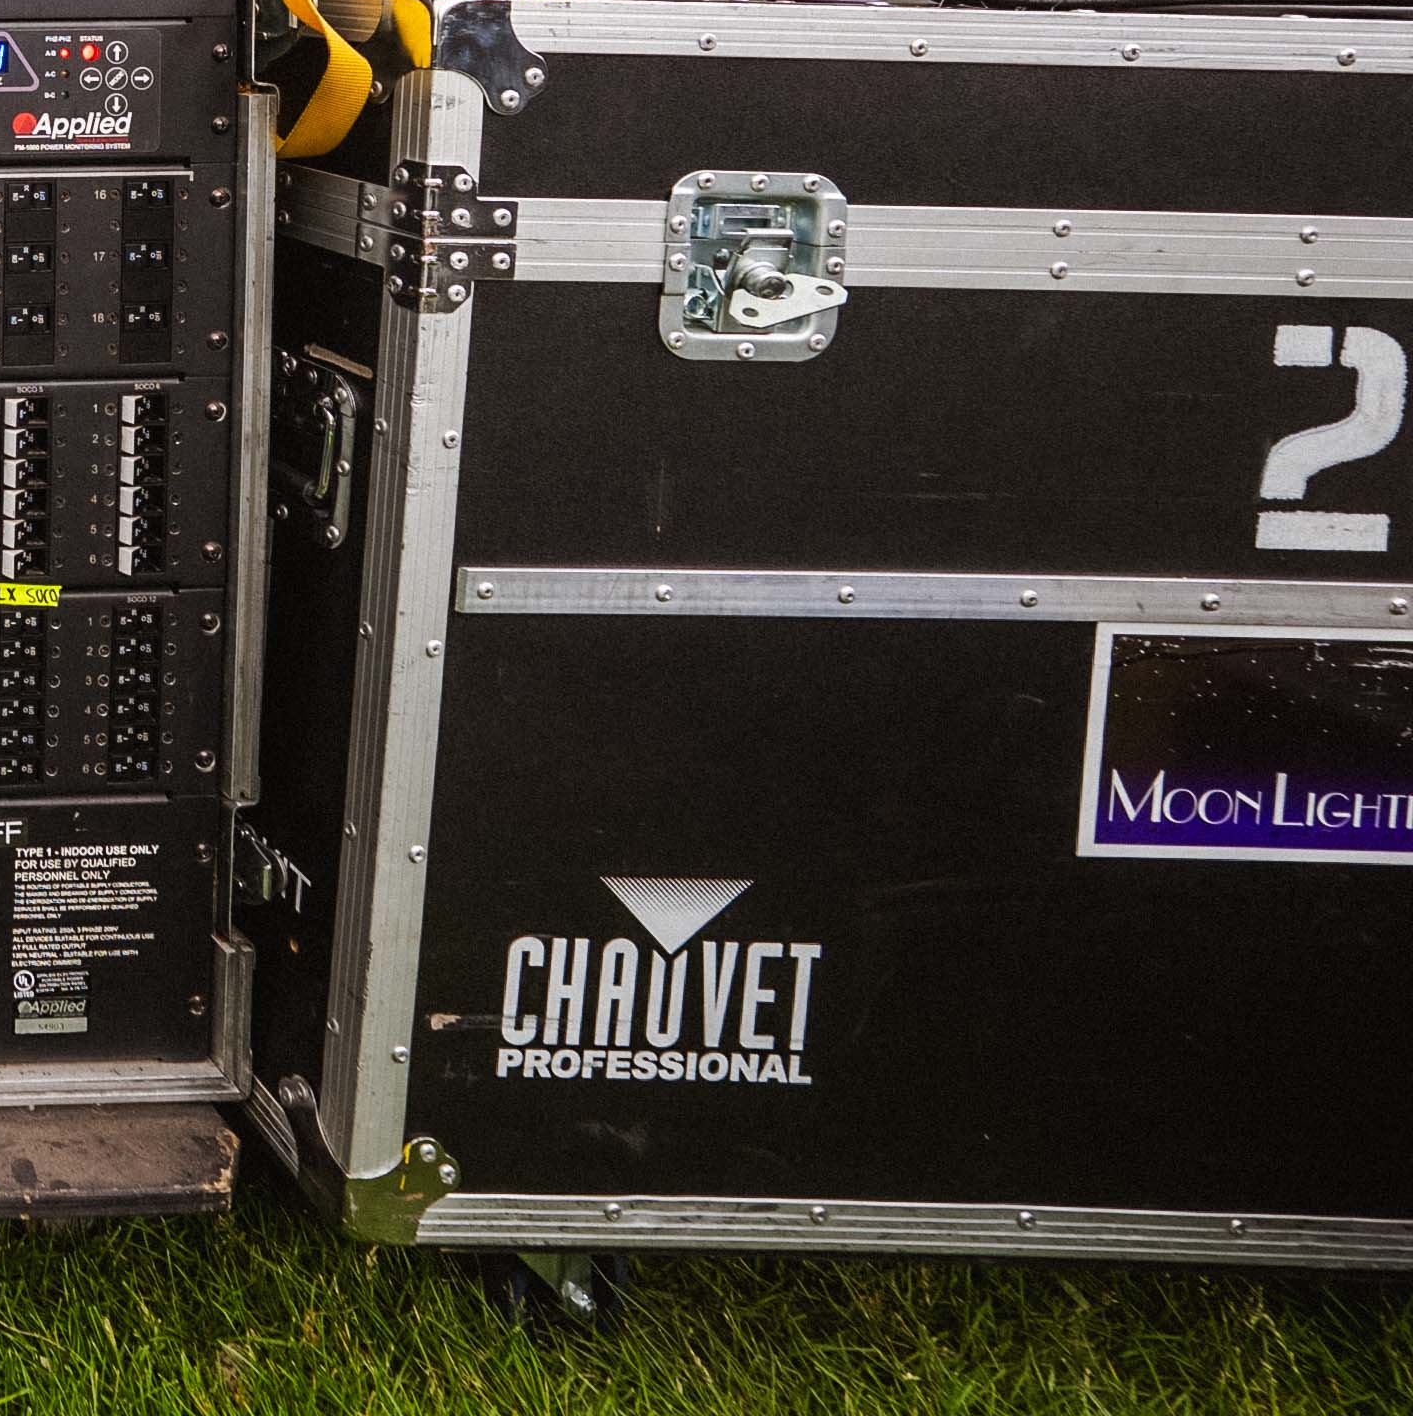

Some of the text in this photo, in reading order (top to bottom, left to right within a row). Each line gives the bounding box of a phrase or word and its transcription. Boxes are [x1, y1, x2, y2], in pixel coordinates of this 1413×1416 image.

[32, 112, 132, 139] Applied
[93, 313, 104, 323] 18
[1255, 324, 1407, 552] 2
[26, 588, 58, 603] SOCO
[15, 845, 159, 857] TYPE 1 INDOOR USE ONLY
[14, 857, 136, 870] FOR USE BY QUALIFIED
[14, 870, 110, 882] PERSONNEL ONLY
[501, 936, 822, 1051] CHAUVET
[31, 999, 86, 1016] Applied
[496, 1048, 812, 1084] PROFESSIONAL
